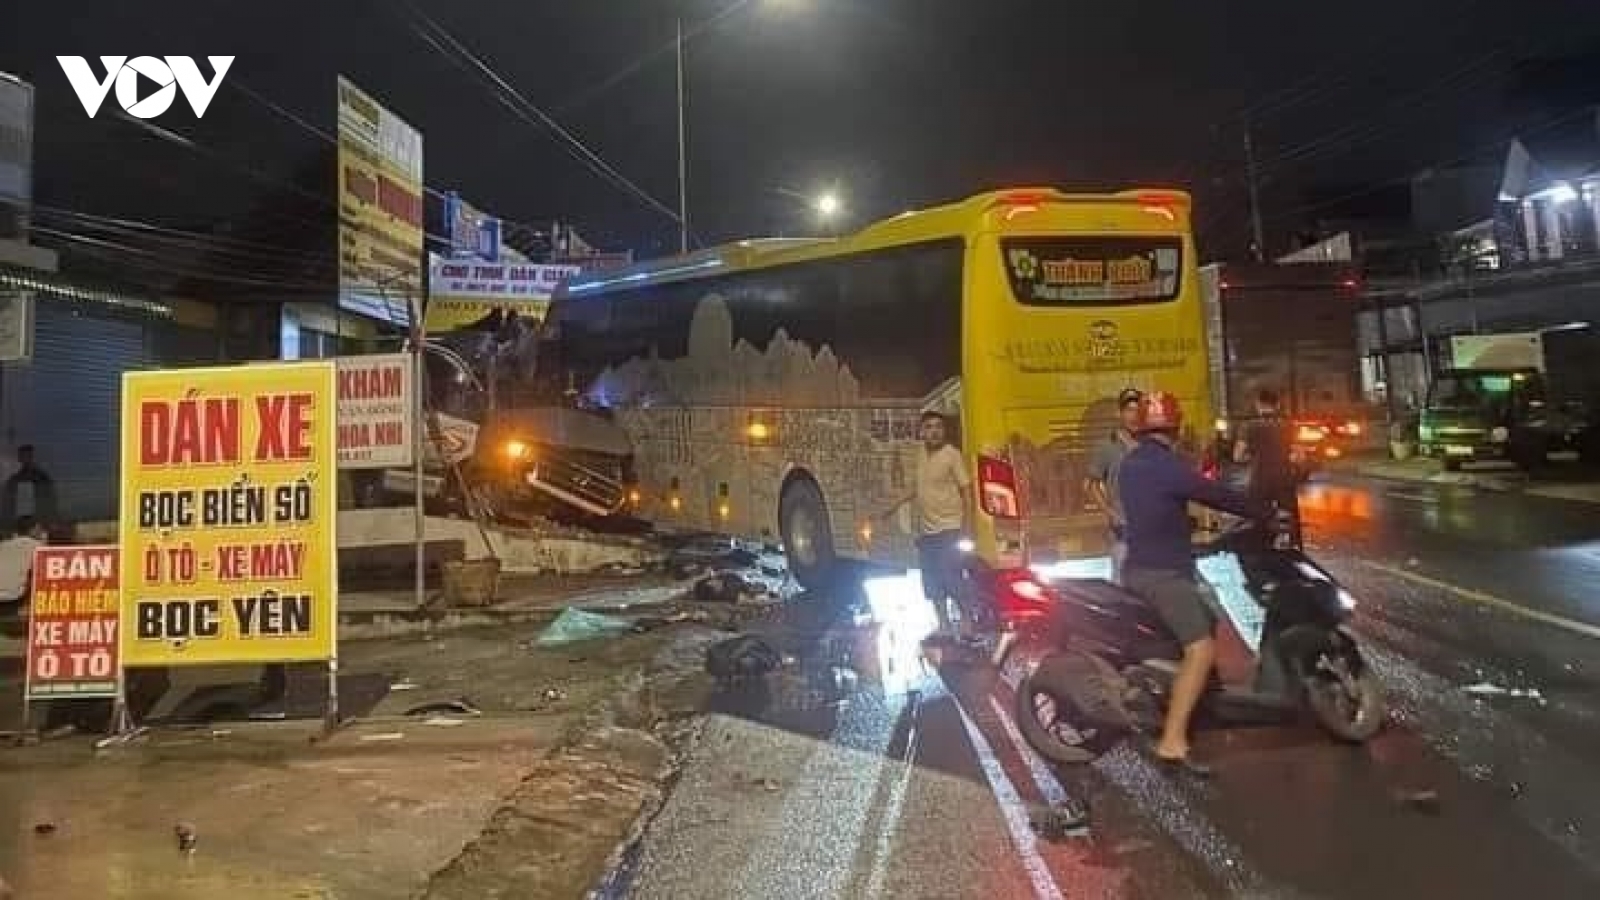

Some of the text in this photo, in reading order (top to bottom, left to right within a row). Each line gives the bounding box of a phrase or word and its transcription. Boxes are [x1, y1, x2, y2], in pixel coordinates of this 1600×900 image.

[254, 394, 313, 459] XE
[139, 470, 318, 536] BỌC BIỂN SỐ
[46, 551, 112, 580] BÁN
[145, 543, 159, 581] Ô
[168, 541, 194, 581] TÔ
[217, 544, 249, 579] XE
[251, 538, 305, 578] MÁY
[35, 615, 117, 645] XE MÁY
[137, 589, 311, 647] BỌC YÊN
[37, 649, 112, 677] Ô TÔ
